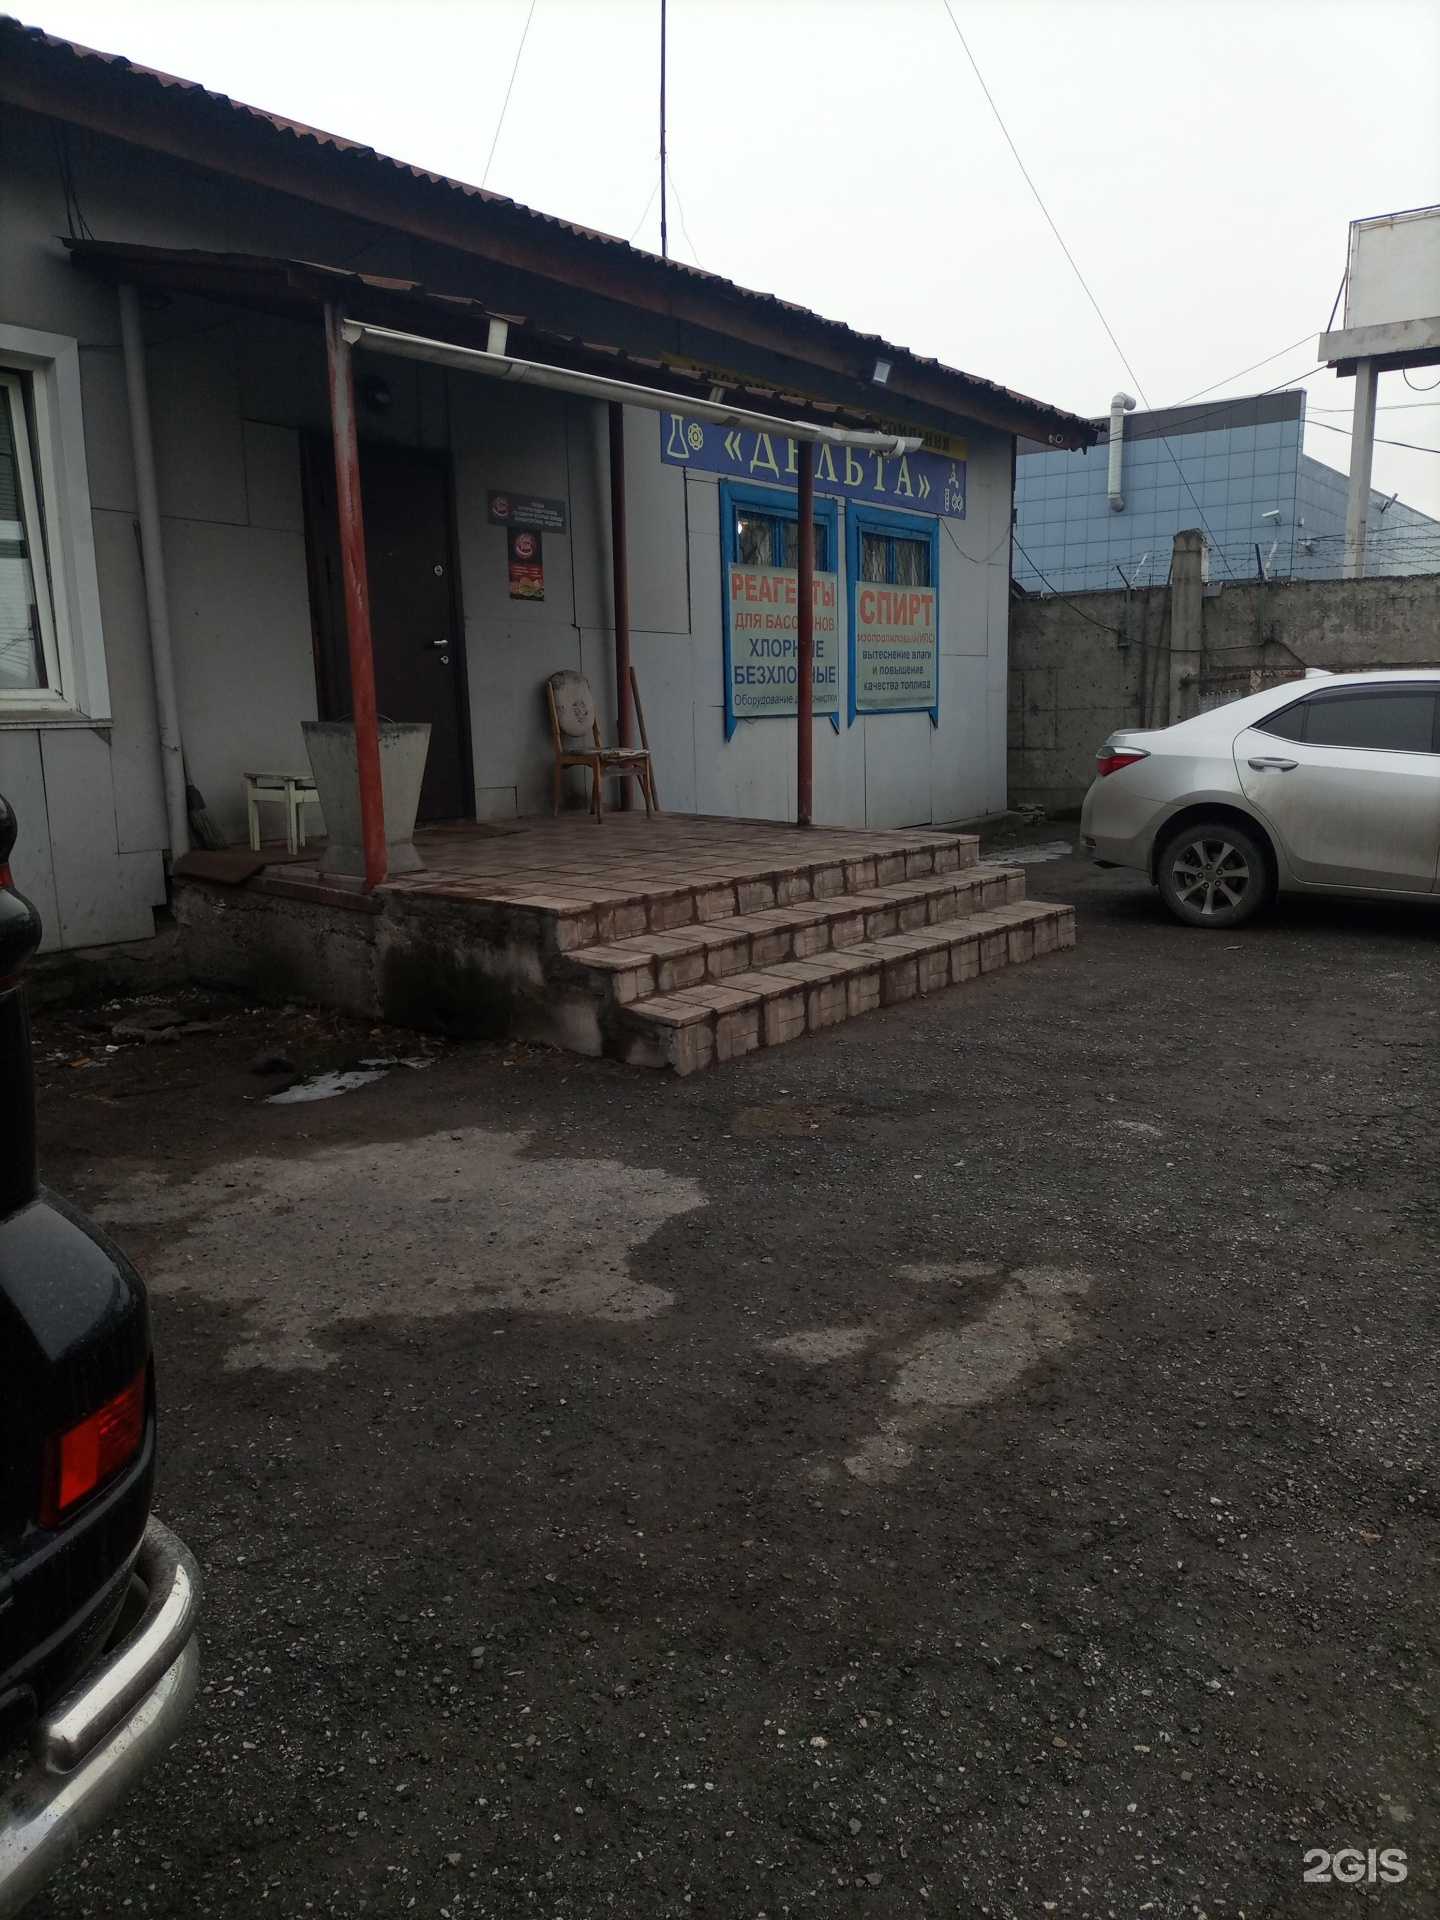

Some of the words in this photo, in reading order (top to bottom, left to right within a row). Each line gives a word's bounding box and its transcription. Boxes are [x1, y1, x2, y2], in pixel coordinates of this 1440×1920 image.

[731, 573, 835, 608] РЕАГЕТЫ
[860, 590, 934, 626] СПИРТ
[735, 612, 762, 631] ДЛЯ
[766, 614, 835, 633] БАССНОВ
[748, 638, 825, 658] ХЛОРЕ
[862, 650, 911, 660] вытеснение
[911, 650, 932, 660] влаги
[734, 665, 836, 685] БЕЗХЛОЫЕ
[880, 665, 924, 675] повышение
[864, 681, 899, 691] качества
[734, 694, 793, 709] Оборудование
